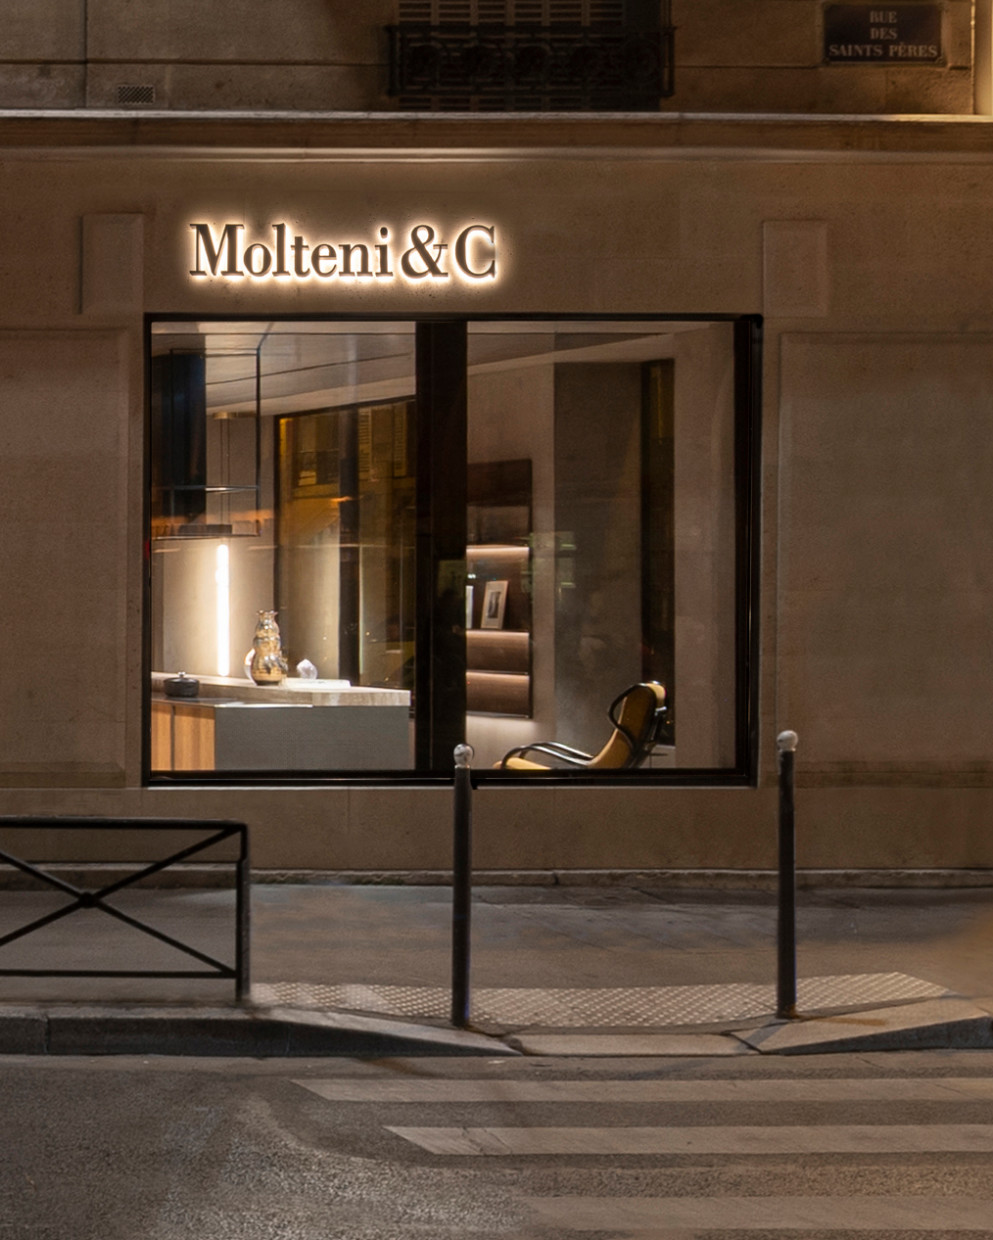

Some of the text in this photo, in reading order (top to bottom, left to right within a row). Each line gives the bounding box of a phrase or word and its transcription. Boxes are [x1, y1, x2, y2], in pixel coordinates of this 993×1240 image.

[869, 10, 898, 24] RUE
[870, 27, 898, 40] DES
[828, 41, 939, 58] SAINTS PÈRES
[189, 222, 497, 279] Molteni&C
